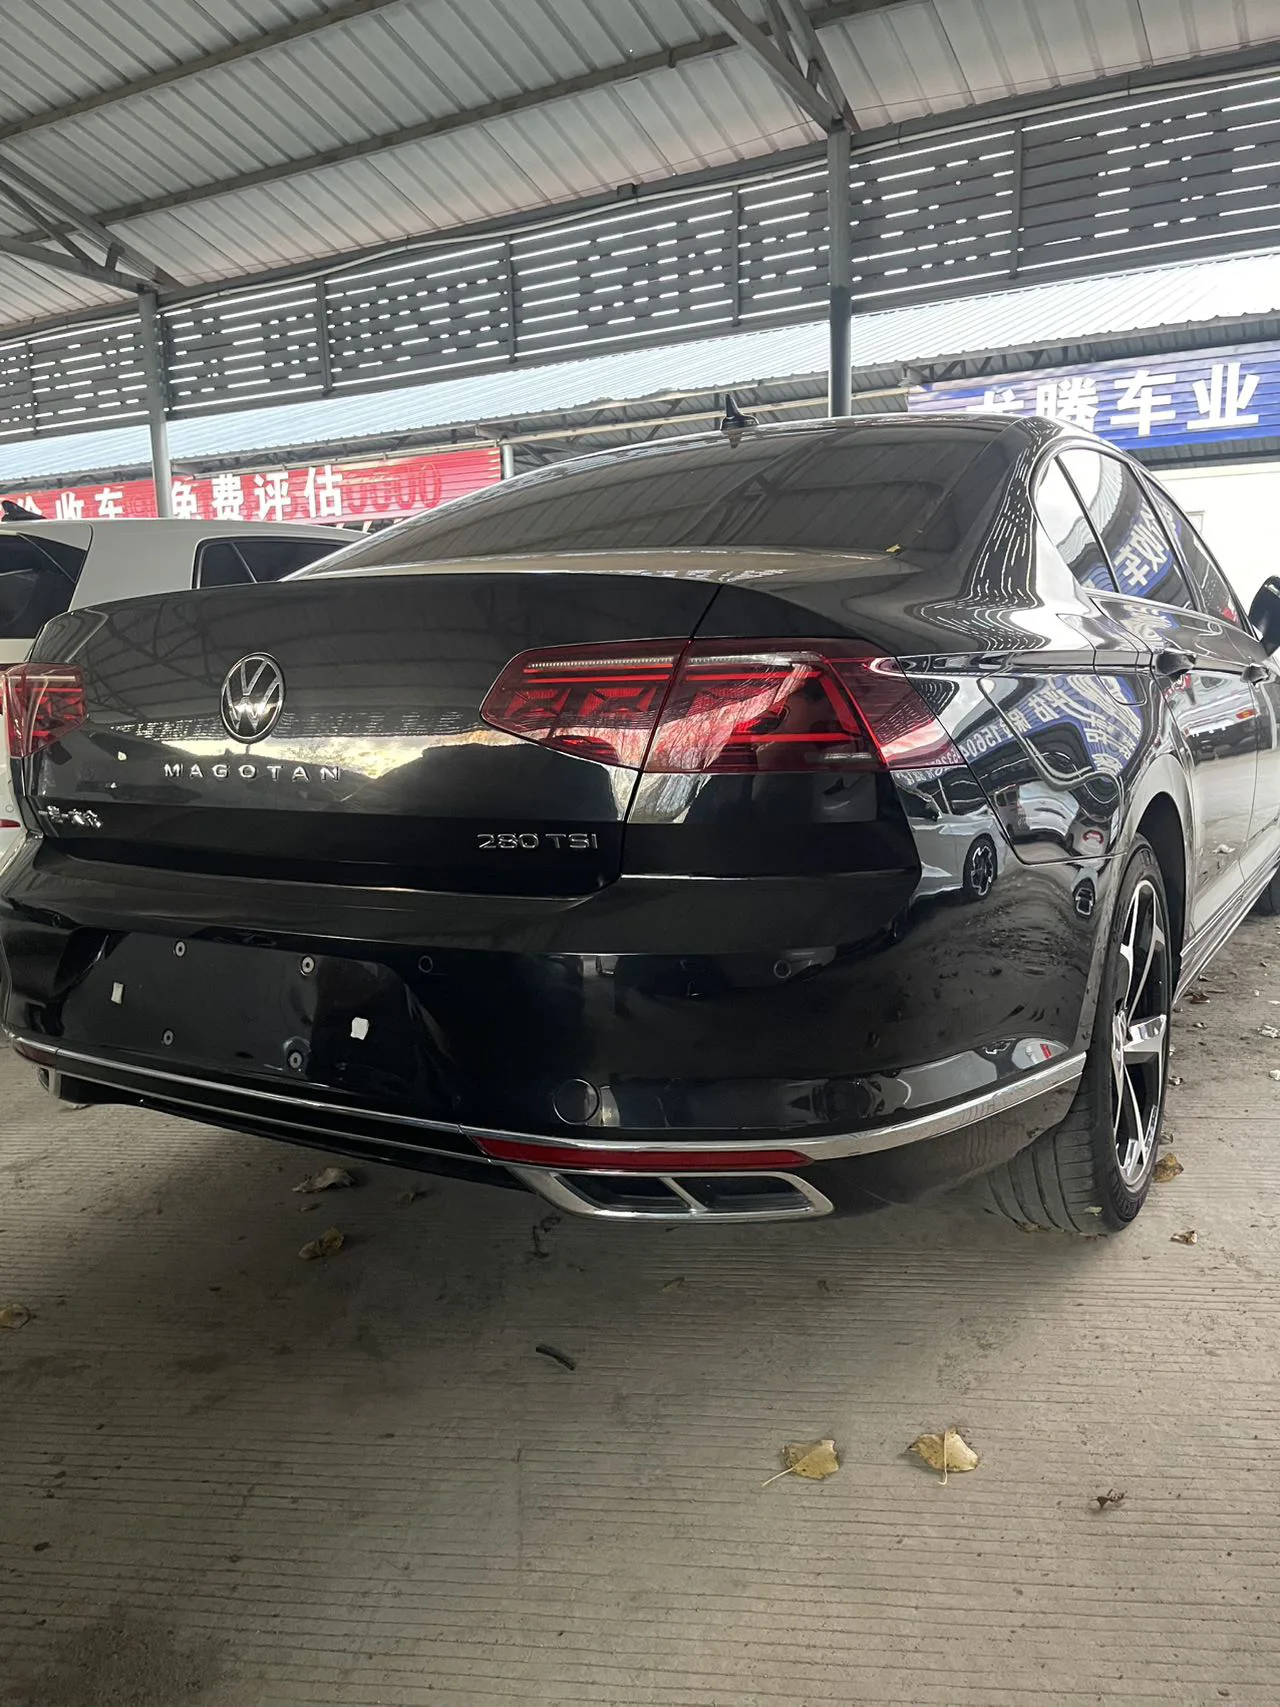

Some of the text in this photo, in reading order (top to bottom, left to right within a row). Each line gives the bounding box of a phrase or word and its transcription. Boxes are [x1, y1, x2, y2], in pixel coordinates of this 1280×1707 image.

[170, 464, 344, 522] 免费评估
[164, 763, 341, 782] MAGOTAN
[476, 832, 599, 849] 280 TSI
